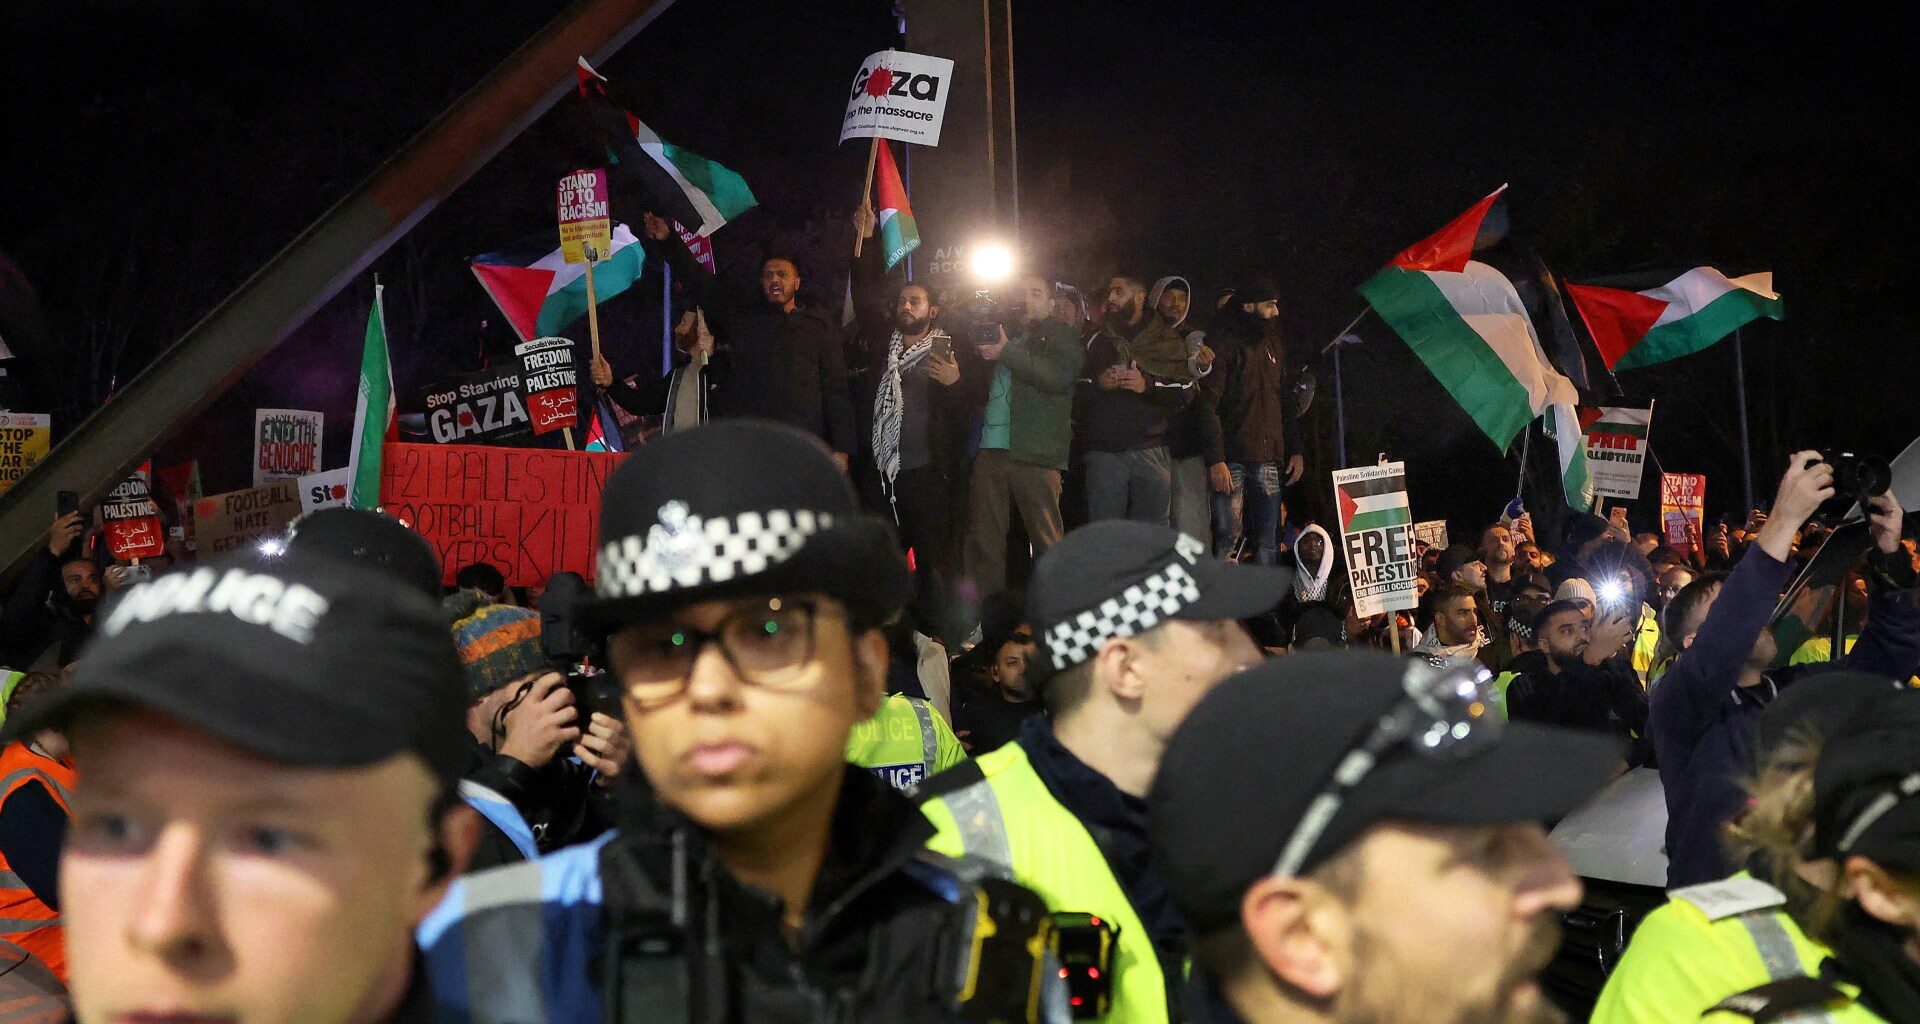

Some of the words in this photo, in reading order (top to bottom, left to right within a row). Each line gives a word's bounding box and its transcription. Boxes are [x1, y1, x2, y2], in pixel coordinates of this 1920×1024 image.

[852, 67, 940, 102] Gza
[857, 105, 872, 116] the
[875, 105, 934, 122] massacre
[559, 172, 597, 192] STAND
[559, 191, 574, 206] UP
[578, 187, 594, 203] TO
[560, 201, 607, 221] RACISM
[523, 349, 572, 371] FREEDOM
[426, 392, 457, 408] Stop
[460, 374, 520, 399] Starving
[431, 390, 528, 444] GAZA
[260, 420, 295, 443] END
[1587, 431, 1639, 450] FREE
[259, 442, 317, 472] GENOCIDE
[383, 449, 432, 500] 421
[1336, 471, 1359, 482] Palestine
[1360, 468, 1388, 479] Solidarity
[1665, 475, 1697, 486] STAND
[1663, 485, 1678, 495] UP
[1681, 485, 1693, 495] TO
[225, 485, 293, 515] FOOTBALL
[1663, 495, 1701, 506] RACISM
[103, 502, 155, 519] PALESTINE
[115, 523, 148, 538] الحرية
[114, 536, 155, 553] لفلسطين
[1345, 524, 1416, 571] FREE
[1357, 589, 1367, 598] END
[1367, 584, 1390, 597] ISRAELI
